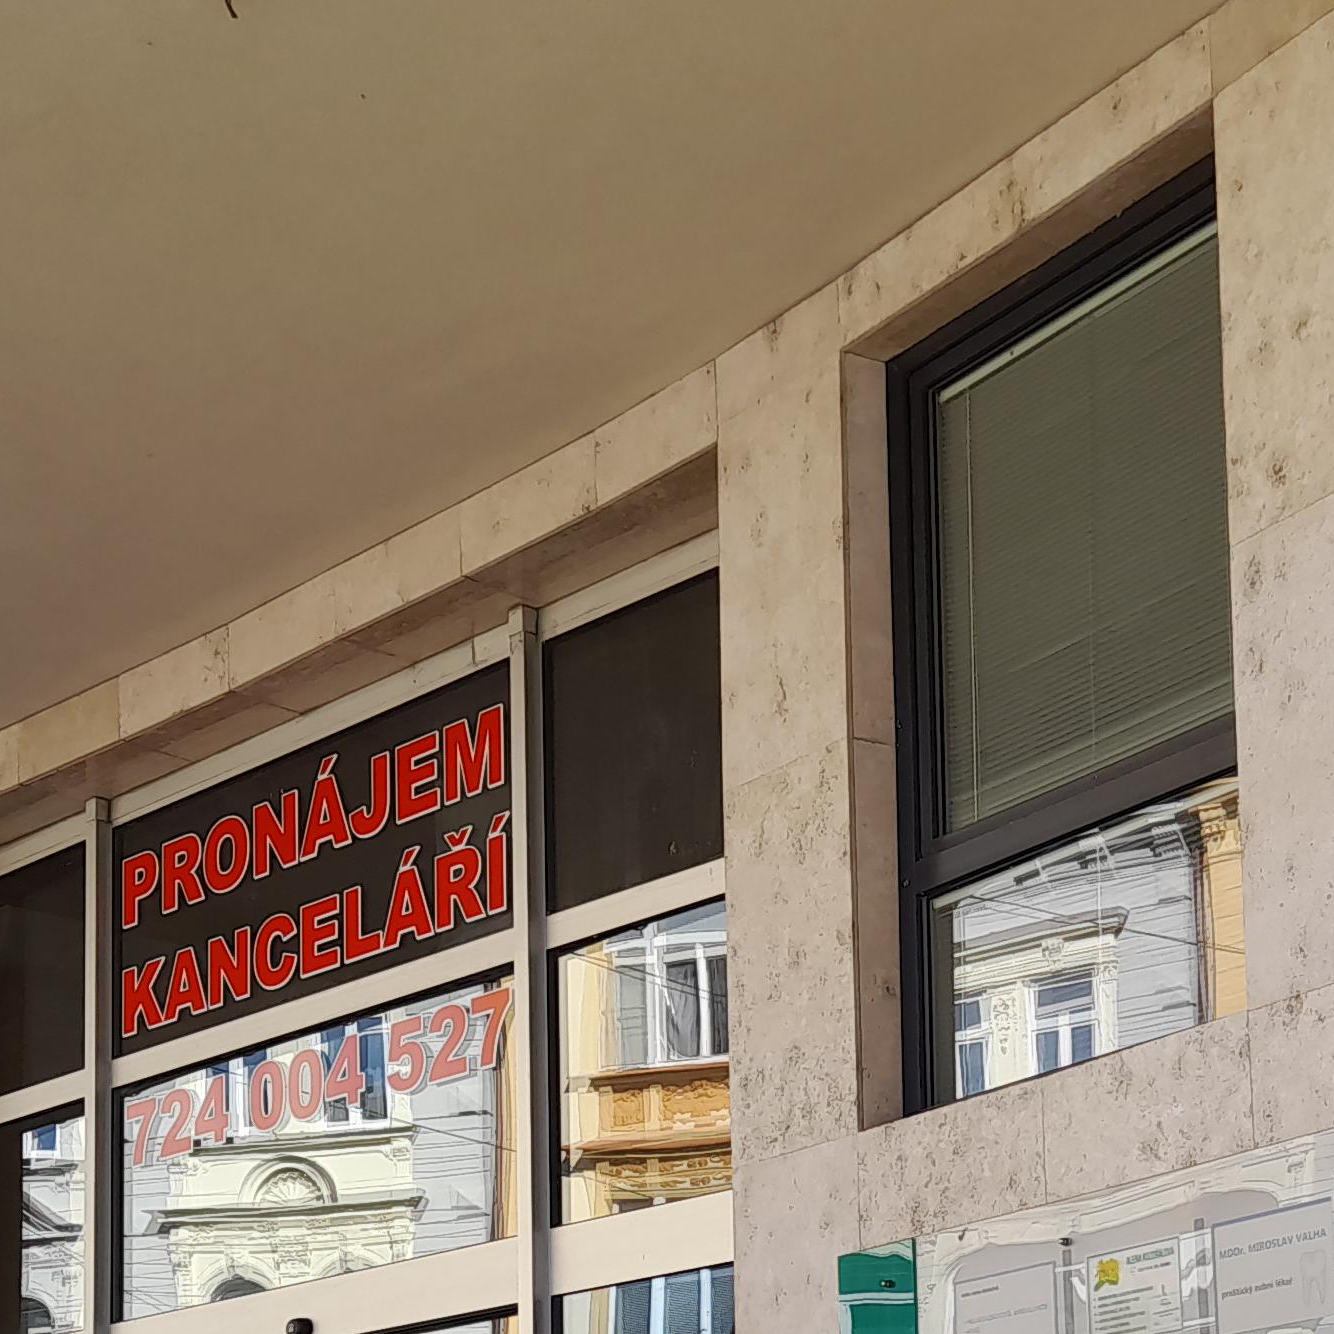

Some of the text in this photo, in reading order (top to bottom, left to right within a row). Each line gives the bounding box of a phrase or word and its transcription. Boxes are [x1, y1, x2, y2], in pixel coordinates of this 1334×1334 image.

[122, 702, 505, 929] PRONÁJEM
[122, 811, 510, 1038] KANCELÁŘÍ
[126, 987, 513, 1168] 724 004 527
[1248, 1234, 1294, 1254] MIROSLAV
[1297, 1227, 1327, 1243] VALHA
